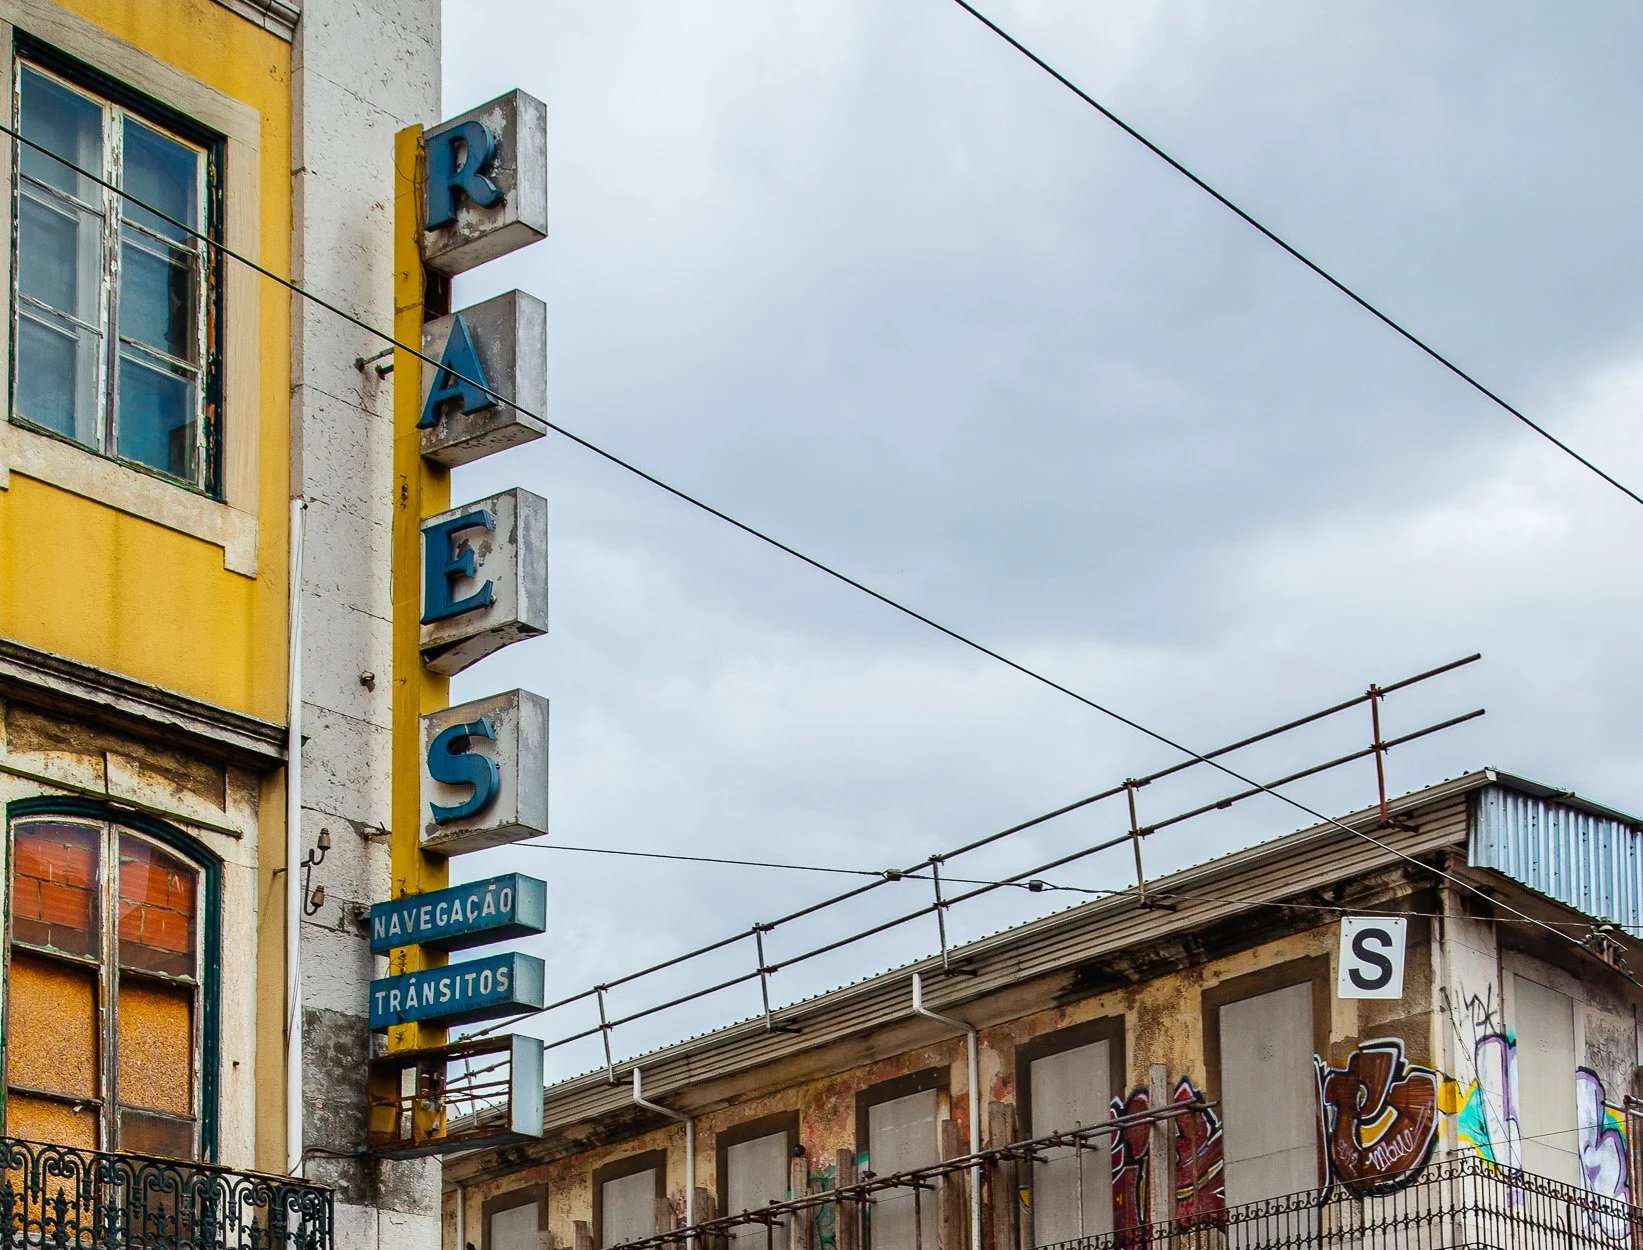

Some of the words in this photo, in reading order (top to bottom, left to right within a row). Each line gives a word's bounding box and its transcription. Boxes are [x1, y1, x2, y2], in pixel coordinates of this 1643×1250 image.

[374, 883, 513, 940] NAVEGAÇÃO
[1348, 927, 1393, 990] S
[374, 965, 511, 1015] TRÂNSITOS
